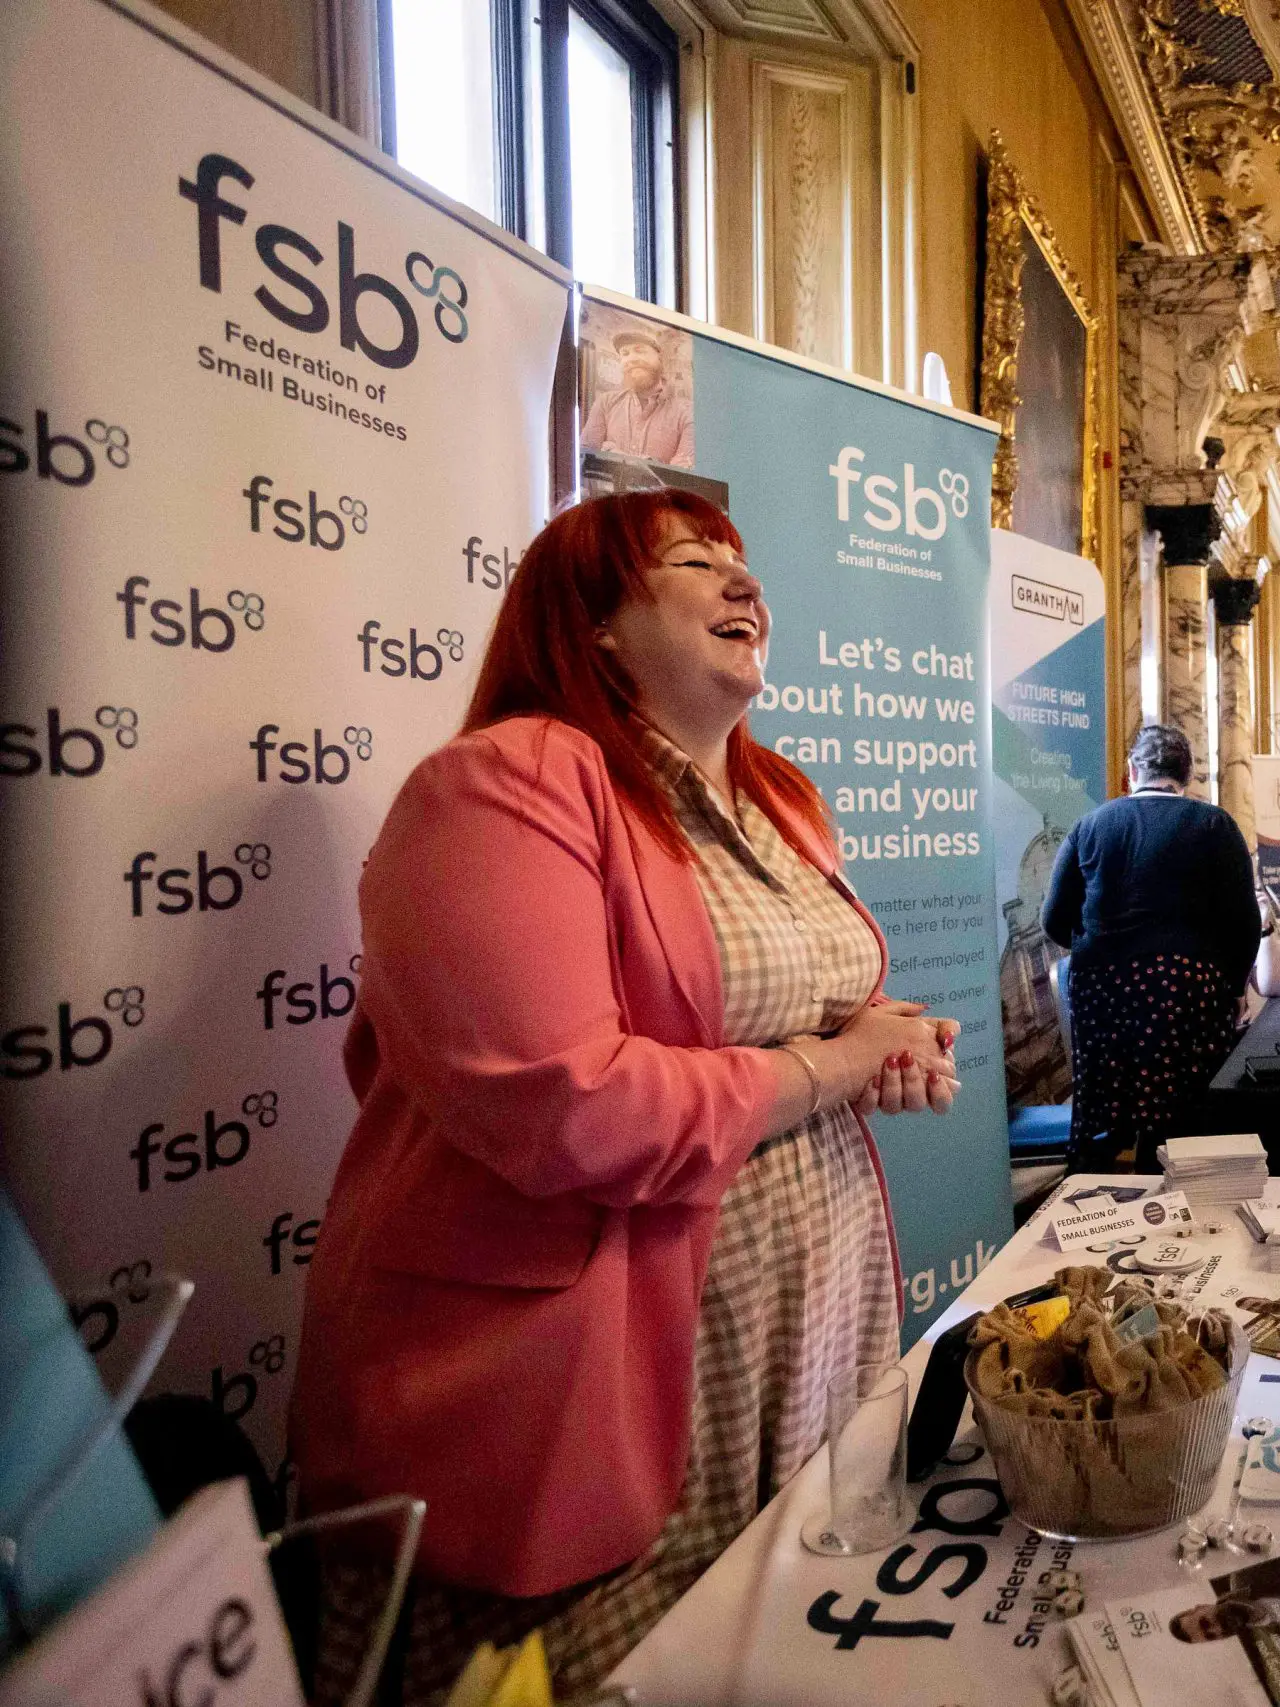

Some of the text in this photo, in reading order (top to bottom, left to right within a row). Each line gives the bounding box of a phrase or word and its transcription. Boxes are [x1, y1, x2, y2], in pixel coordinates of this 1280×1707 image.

[179, 153, 420, 369] fsb
[225, 319, 386, 403] Federation of
[198, 345, 407, 441] Small Businesses
[0, 409, 96, 487] sb
[242, 475, 346, 552] fsb
[828, 446, 947, 541] fsb
[836, 550, 943, 581] Small Businesses
[849, 534, 932, 561] Federation of
[116, 576, 236, 653] fsb
[1017, 586, 1079, 619] GRANTHAM
[357, 620, 444, 682] fsb
[819, 630, 975, 681] Let’s chat
[750, 683, 976, 725] bout how we
[1012, 681, 1086, 708] FUTURE HIGH
[1007, 703, 1090, 729] STREETS FUND
[0, 707, 106, 778] sb
[249, 724, 351, 785] fsb
[775, 735, 977, 774] can support
[1030, 747, 1072, 770] Creating
[835, 780, 978, 820] and your
[1063, 774, 1088, 790] Town
[838, 824, 980, 862] business
[124, 851, 244, 917] fsb
[870, 893, 983, 914] matter what your
[905, 920, 937, 934] here
[942, 917, 960, 929] for
[961, 916, 983, 929] you
[890, 949, 985, 974] Self-employed
[256, 963, 357, 1030] fsb
[949, 985, 985, 1002] owner
[0, 1002, 114, 1080] sb
[130, 1111, 252, 1193] fsb
[1056, 1208, 1119, 1228] FEDERATION OF
[1061, 1218, 1135, 1242] SMALL BUSINESSES
[263, 1212, 321, 1274] fs
[1153, 1245, 1180, 1263] fsb
[806, 1477, 1010, 1652] fsb
[984, 1529, 1043, 1625] Federatio
[1127, 1611, 1151, 1638] fsb
